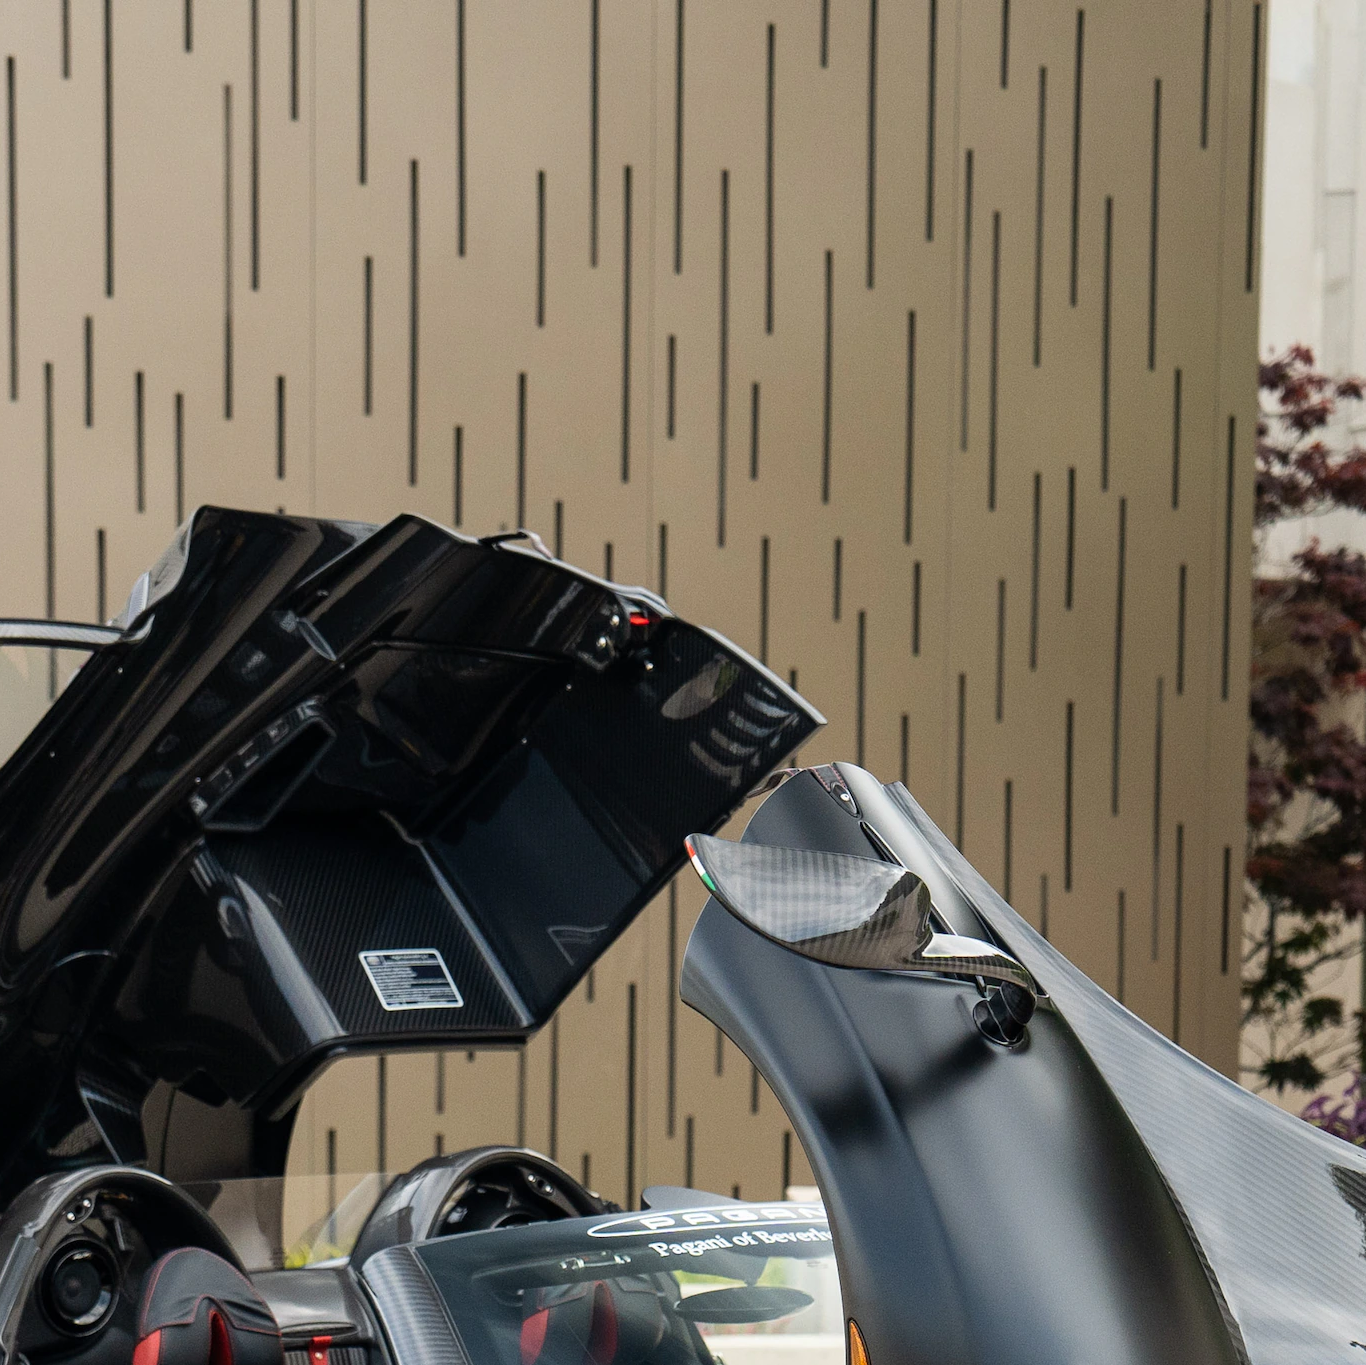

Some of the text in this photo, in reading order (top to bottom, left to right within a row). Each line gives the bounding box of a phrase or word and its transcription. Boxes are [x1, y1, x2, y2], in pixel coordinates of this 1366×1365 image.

[640, 1208, 826, 1230] PAGAN
[648, 1235, 733, 1257] Pagani
[732, 1231, 759, 1246] of
